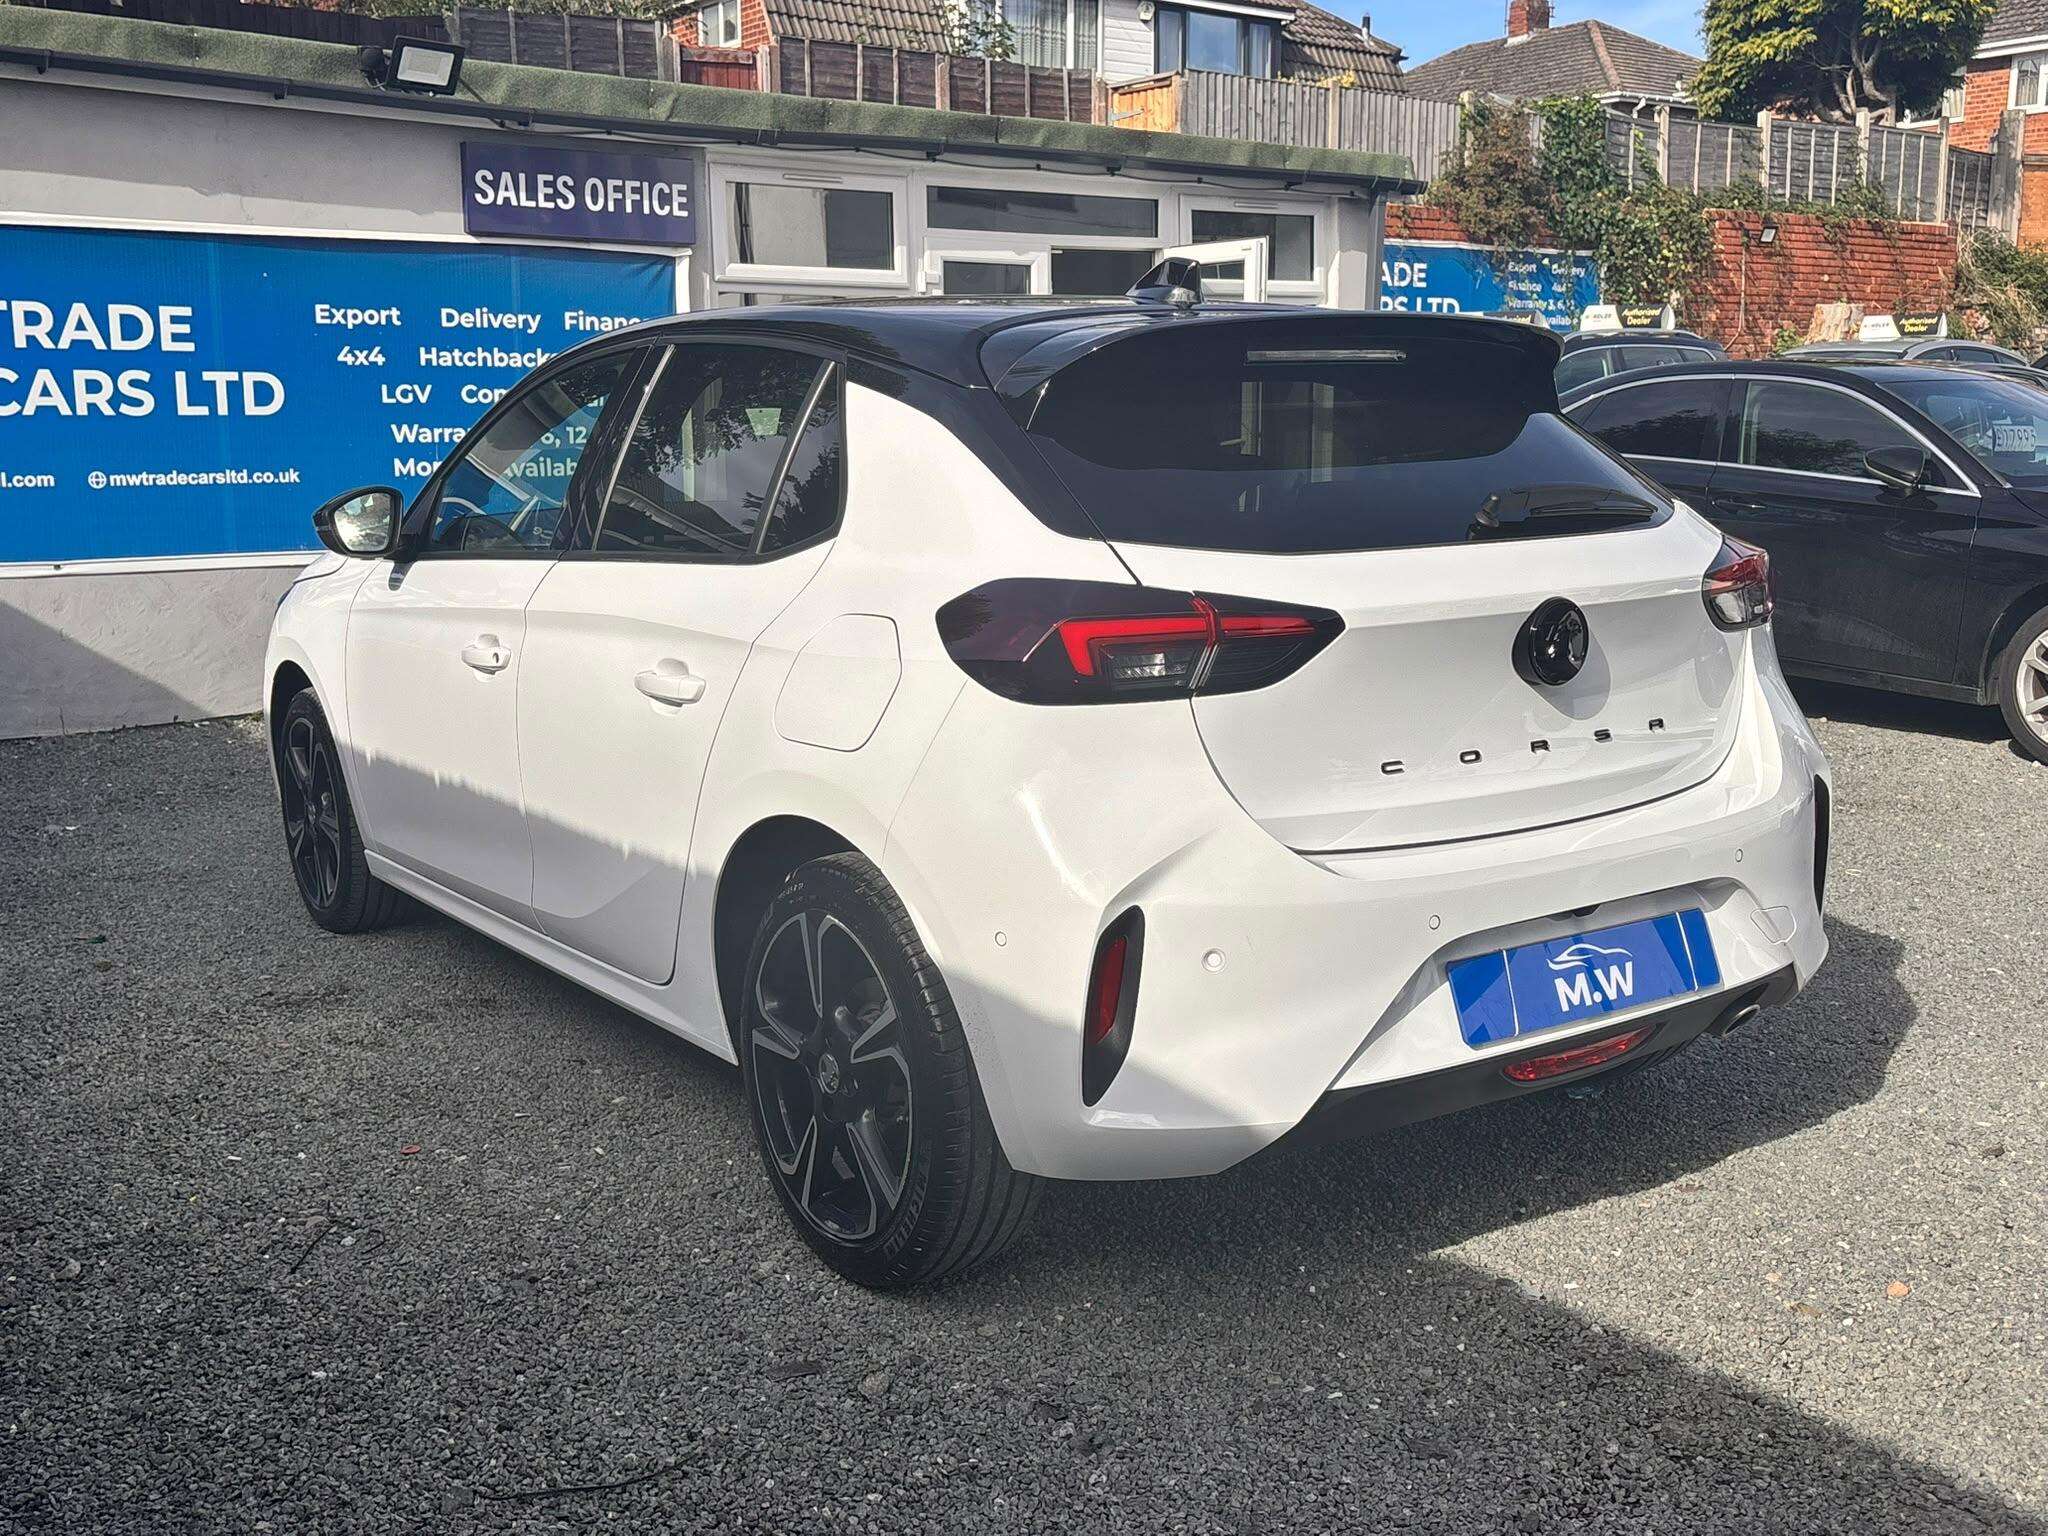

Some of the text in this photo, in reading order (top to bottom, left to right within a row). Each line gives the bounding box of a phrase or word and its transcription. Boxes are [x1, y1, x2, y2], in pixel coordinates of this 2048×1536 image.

[474, 169, 689, 217] SALES OFFICE
[1508, 261, 1537, 273] Export
[0, 299, 196, 352] RADE
[314, 304, 402, 327] Export
[441, 308, 541, 333] Delivery
[1626, 316, 1652, 325] Dealer
[1904, 324, 1928, 333] Dealer
[337, 346, 558, 368] 4x4 Hatchback
[174, 370, 286, 416] LTD
[381, 384, 432, 404] LGV
[109, 467, 301, 487] mwtradecarsltd.co.uk
[1380, 717, 1665, 776] CORSA
[1554, 960, 1634, 1012] M.W
